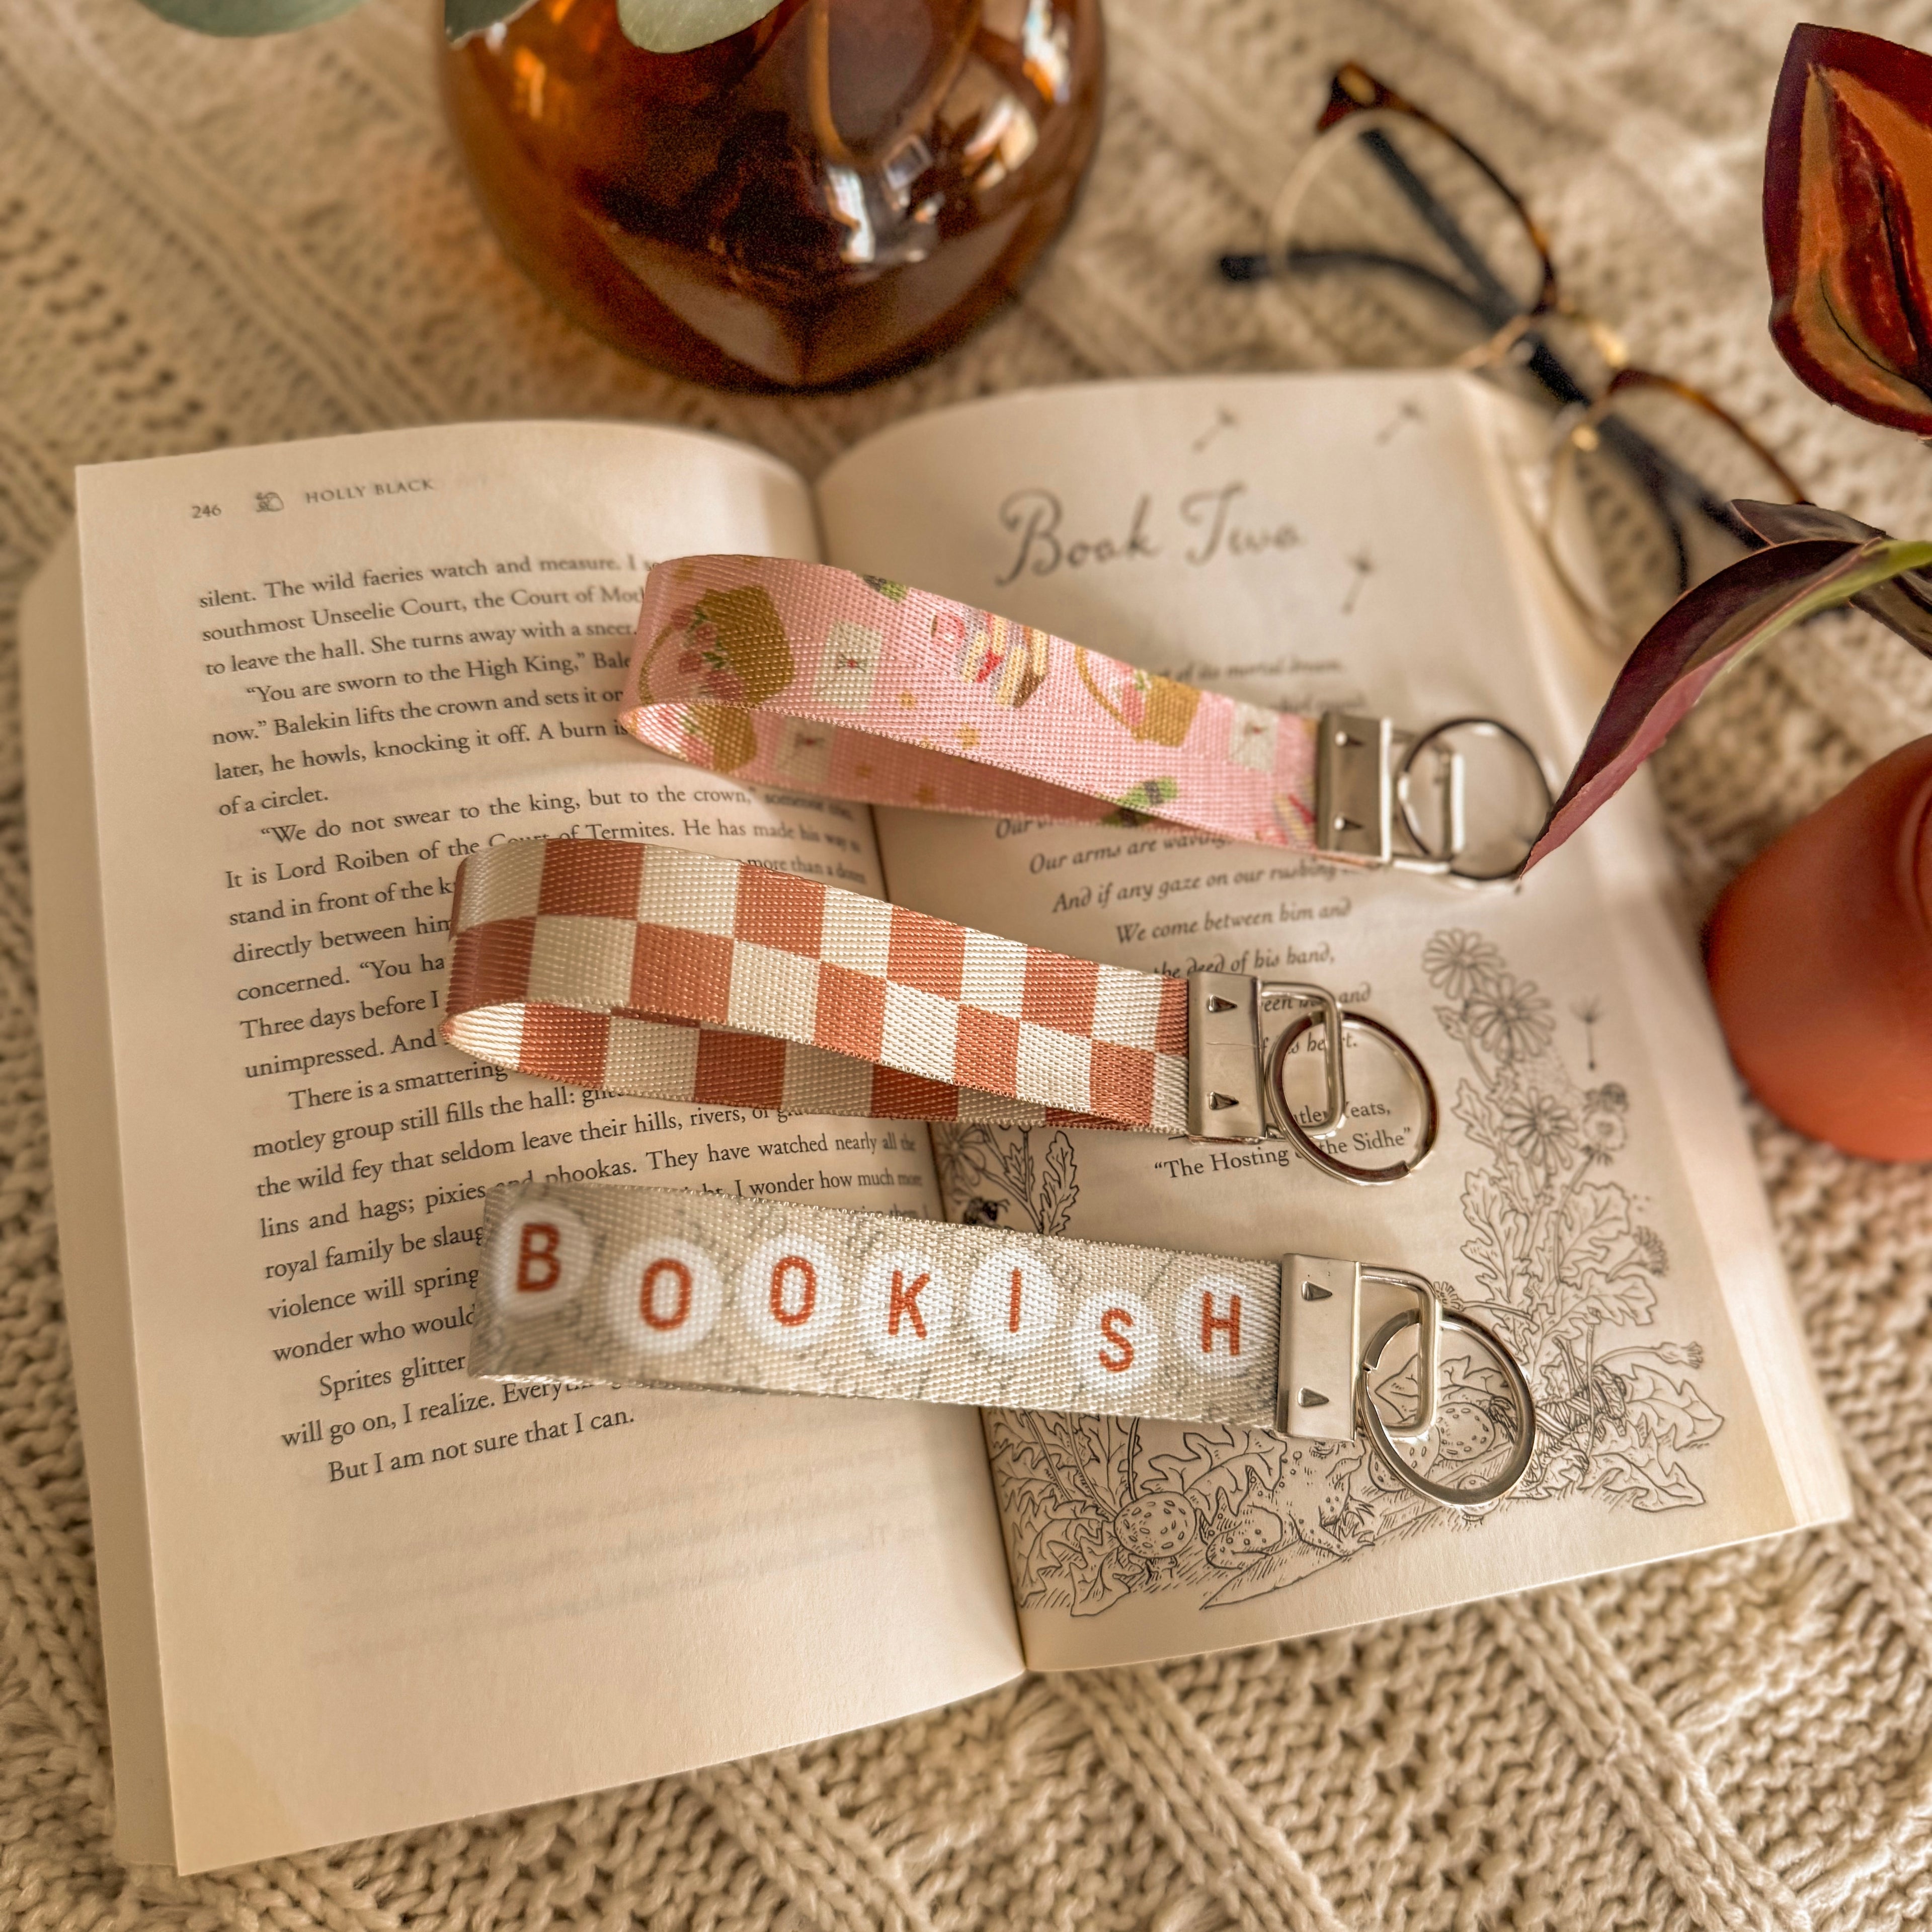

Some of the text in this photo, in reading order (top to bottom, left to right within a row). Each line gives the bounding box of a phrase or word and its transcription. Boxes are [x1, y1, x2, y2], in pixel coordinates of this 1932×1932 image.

[192, 479, 432, 519] 246 HOLLY BLACK
[995, 478, 1301, 588] Book Two
[199, 559, 488, 608] silent. The wild faeries watch
[202, 592, 504, 641] southmost Unseelie Court, the
[206, 620, 565, 675] to leave the hall. She turns away with
[246, 652, 585, 702] “You are sworn to the High King,”
[212, 689, 579, 745] now.” Balekin lifts the crown and sets
[215, 721, 607, 780] later, he howls, knocking it off. A burn
[218, 786, 328, 816] of a circlet.
[261, 785, 685, 843] “We do not swear to the king, but the
[225, 840, 441, 889] It is Lord Roiben of
[1029, 839, 1157, 874] Our arms are
[229, 900, 285, 926] stand
[291, 898, 312, 916] in
[317, 892, 369, 912] front
[374, 882, 397, 903] of
[400, 880, 433, 900] the
[1052, 868, 1265, 913] And if any gaze on our
[233, 926, 406, 963] directly between
[1115, 922, 1145, 945] We
[1152, 920, 1198, 937] come
[1203, 910, 1273, 932] between
[1319, 896, 1352, 919] and
[237, 959, 412, 1001] concerned. “You
[1230, 950, 1250, 974] of
[239, 995, 426, 1039] Three days before
[245, 1028, 438, 1078] unimpressed. And
[288, 1063, 507, 1110] There is a smattering
[253, 1130, 326, 1157] motley
[332, 1121, 394, 1150] group
[400, 1106, 439, 1131] still
[446, 1100, 484, 1123] fills
[490, 1095, 523, 1116] the
[528, 1085, 575, 1110] hall:
[257, 1107, 746, 1197] the wild fey that seldom leave their hills, rivers,
[1154, 1159, 1204, 1179] “The
[1211, 1145, 1289, 1171] Hosting
[1352, 1126, 1411, 1151] Sidhe”
[260, 1132, 877, 1238] lins and hags; pixies They have watched nearly
[749, 1167, 895, 1196] wonder how much
[266, 1233, 426, 1281] royal family be
[268, 1267, 479, 1319] violence will spring
[516, 1221, 1241, 1373] BOOKISH
[273, 1321, 406, 1361] wonder who
[319, 1356, 466, 1401] Sprites glitter
[281, 1392, 496, 1446] will go on, I realize.
[328, 1411, 634, 1483] But I am not sure that I can.
